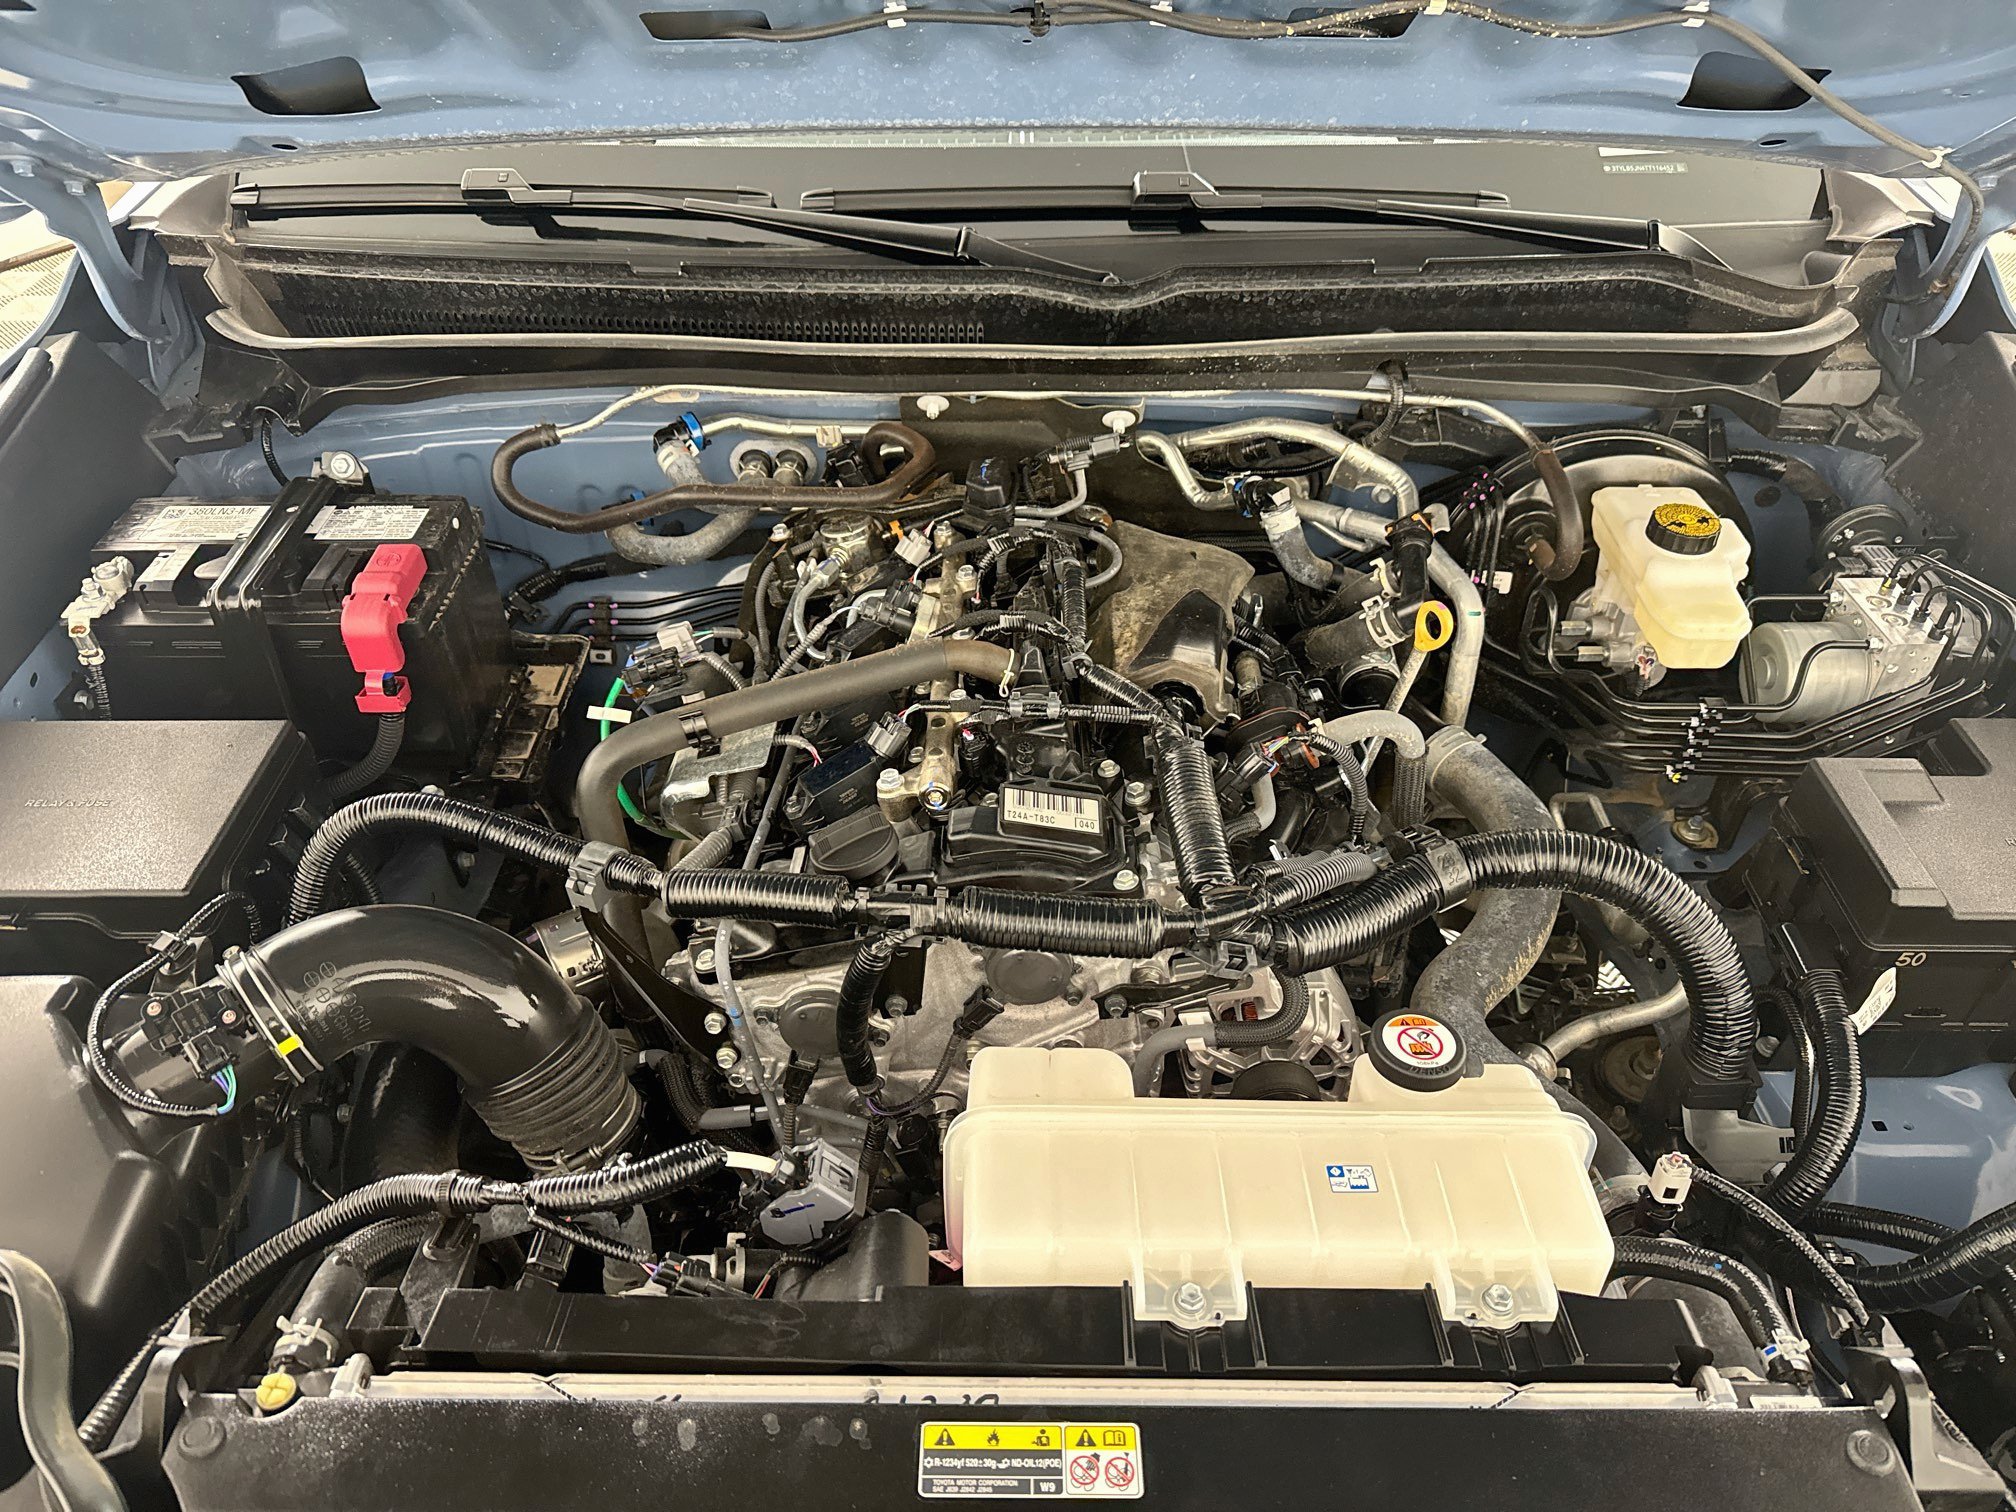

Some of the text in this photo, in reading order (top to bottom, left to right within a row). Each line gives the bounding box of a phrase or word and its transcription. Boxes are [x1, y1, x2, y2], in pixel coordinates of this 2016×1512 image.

[188, 507, 259, 515] 380LN3-MF
[25, 799, 67, 807] RELAY
[78, 799, 113, 807] FUSE
[1007, 810, 1056, 825] T24A-T83C
[1079, 820, 1095, 830] 040
[1895, 952, 1927, 967] 50
[934, 1458, 964, 1469] R-1234yf
[978, 1479, 1019, 1487] CORPORATION
[1040, 1482, 1056, 1492] W9
